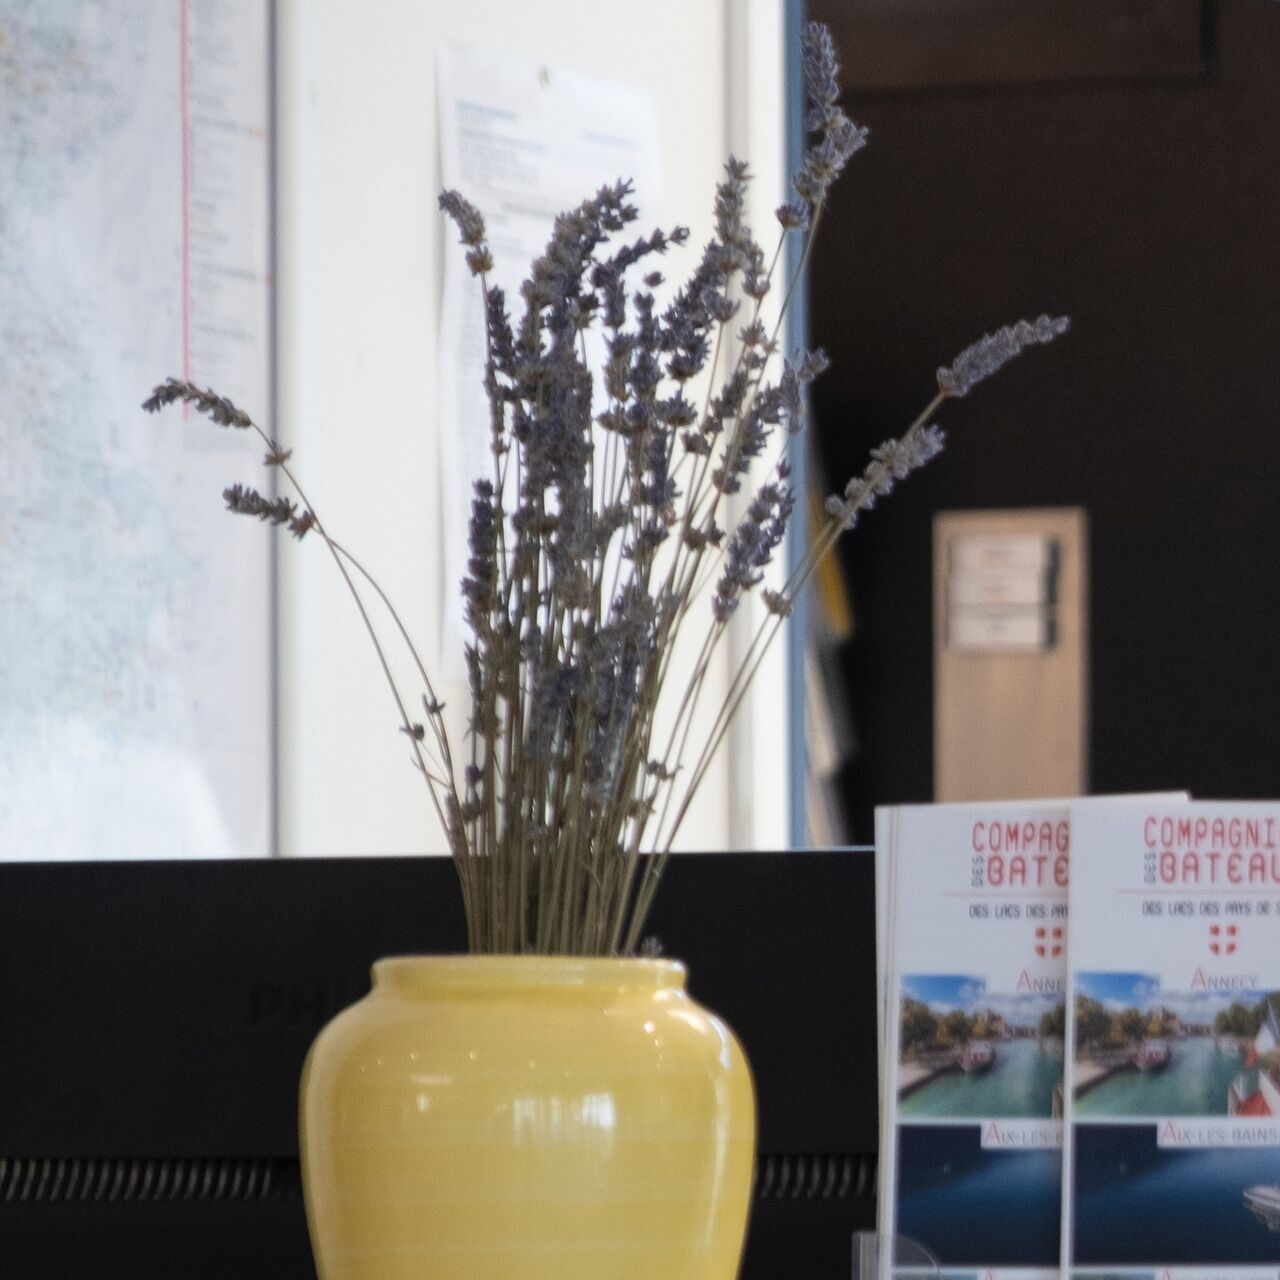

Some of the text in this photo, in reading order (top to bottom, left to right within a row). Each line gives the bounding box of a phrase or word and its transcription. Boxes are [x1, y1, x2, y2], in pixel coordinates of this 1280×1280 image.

[968, 903, 989, 919] DES
[994, 903, 1021, 919] LACS
[1025, 903, 1047, 919] DES
[1141, 901, 1162, 917] DES
[1168, 901, 1194, 917] LACS
[1199, 901, 1220, 917] DES
[1225, 900, 1252, 916] PAYS
[1256, 900, 1270, 916] DE
